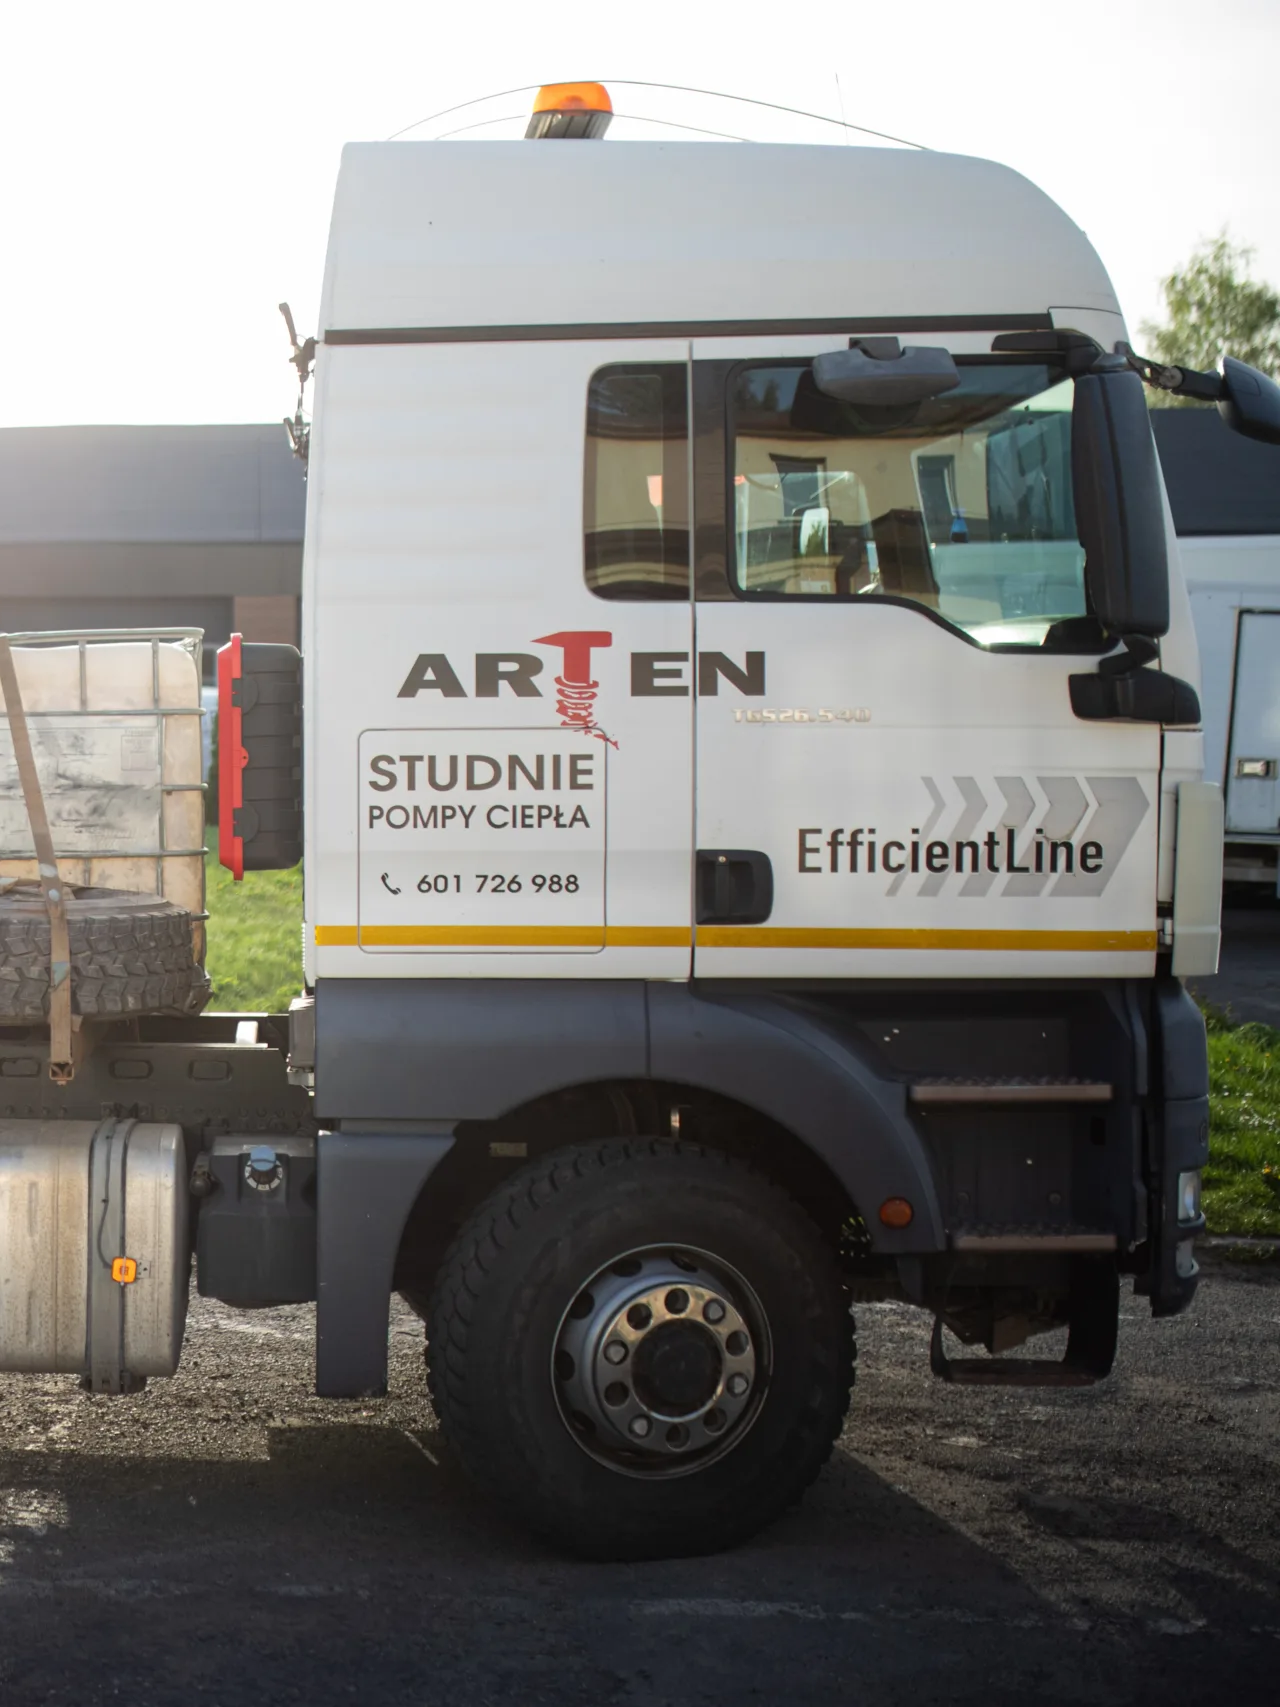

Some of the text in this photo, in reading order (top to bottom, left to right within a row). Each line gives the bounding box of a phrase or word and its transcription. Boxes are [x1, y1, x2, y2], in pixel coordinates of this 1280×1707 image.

[396, 630, 766, 726] ARTEN
[368, 754, 594, 792] STUDNIE
[368, 805, 590, 829] POMPY CIEPŁA
[798, 827, 1104, 875] EfficientLine
[417, 874, 580, 893] 601 726 988
